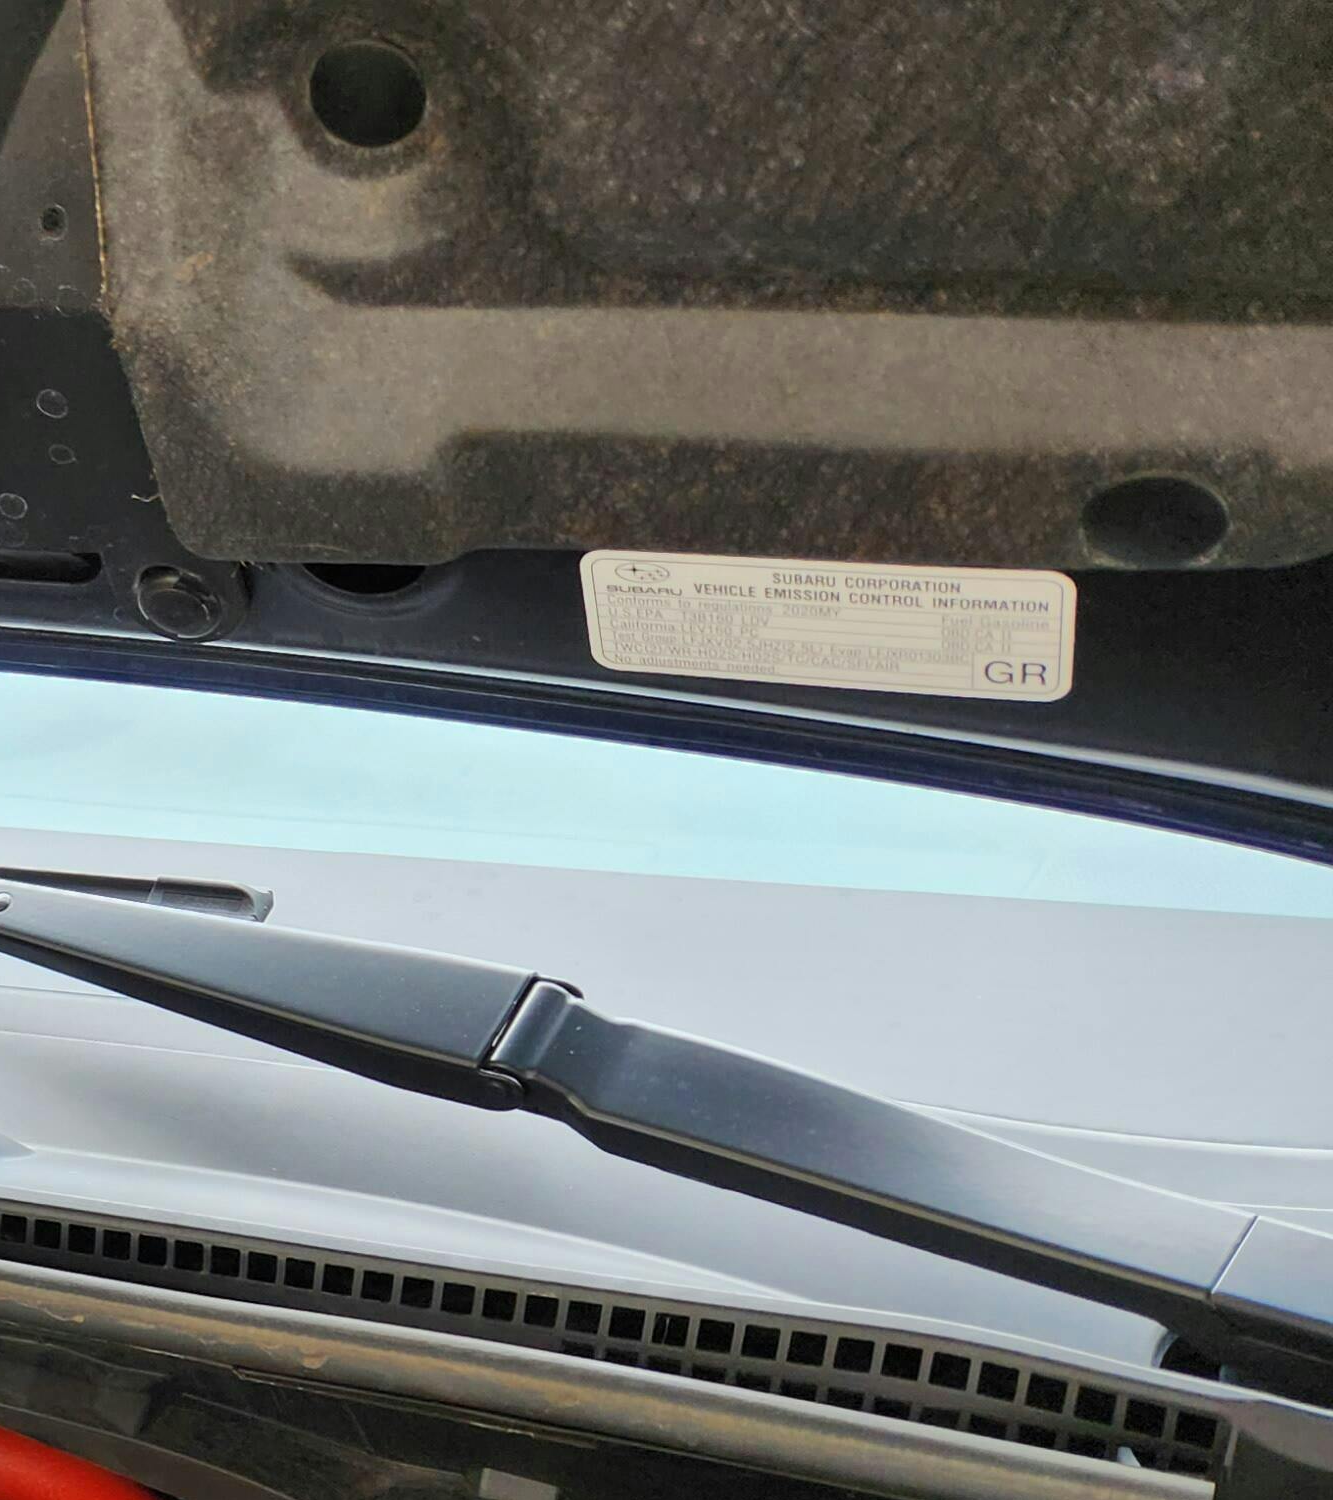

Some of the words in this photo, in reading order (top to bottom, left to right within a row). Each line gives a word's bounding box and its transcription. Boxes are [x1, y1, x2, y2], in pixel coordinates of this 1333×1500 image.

[605, 584, 683, 597] SUBARU
[772, 572, 836, 588] SUBARU
[844, 575, 962, 594] CORPORATION
[608, 595, 671, 608] Conforms
[678, 599, 691, 609] to
[693, 583, 756, 599] VEHICLE
[764, 588, 841, 603] EMISSION
[849, 592, 923, 608] CONTROL
[932, 597, 1050, 613] INFORMATION
[983, 659, 1048, 687] GR
